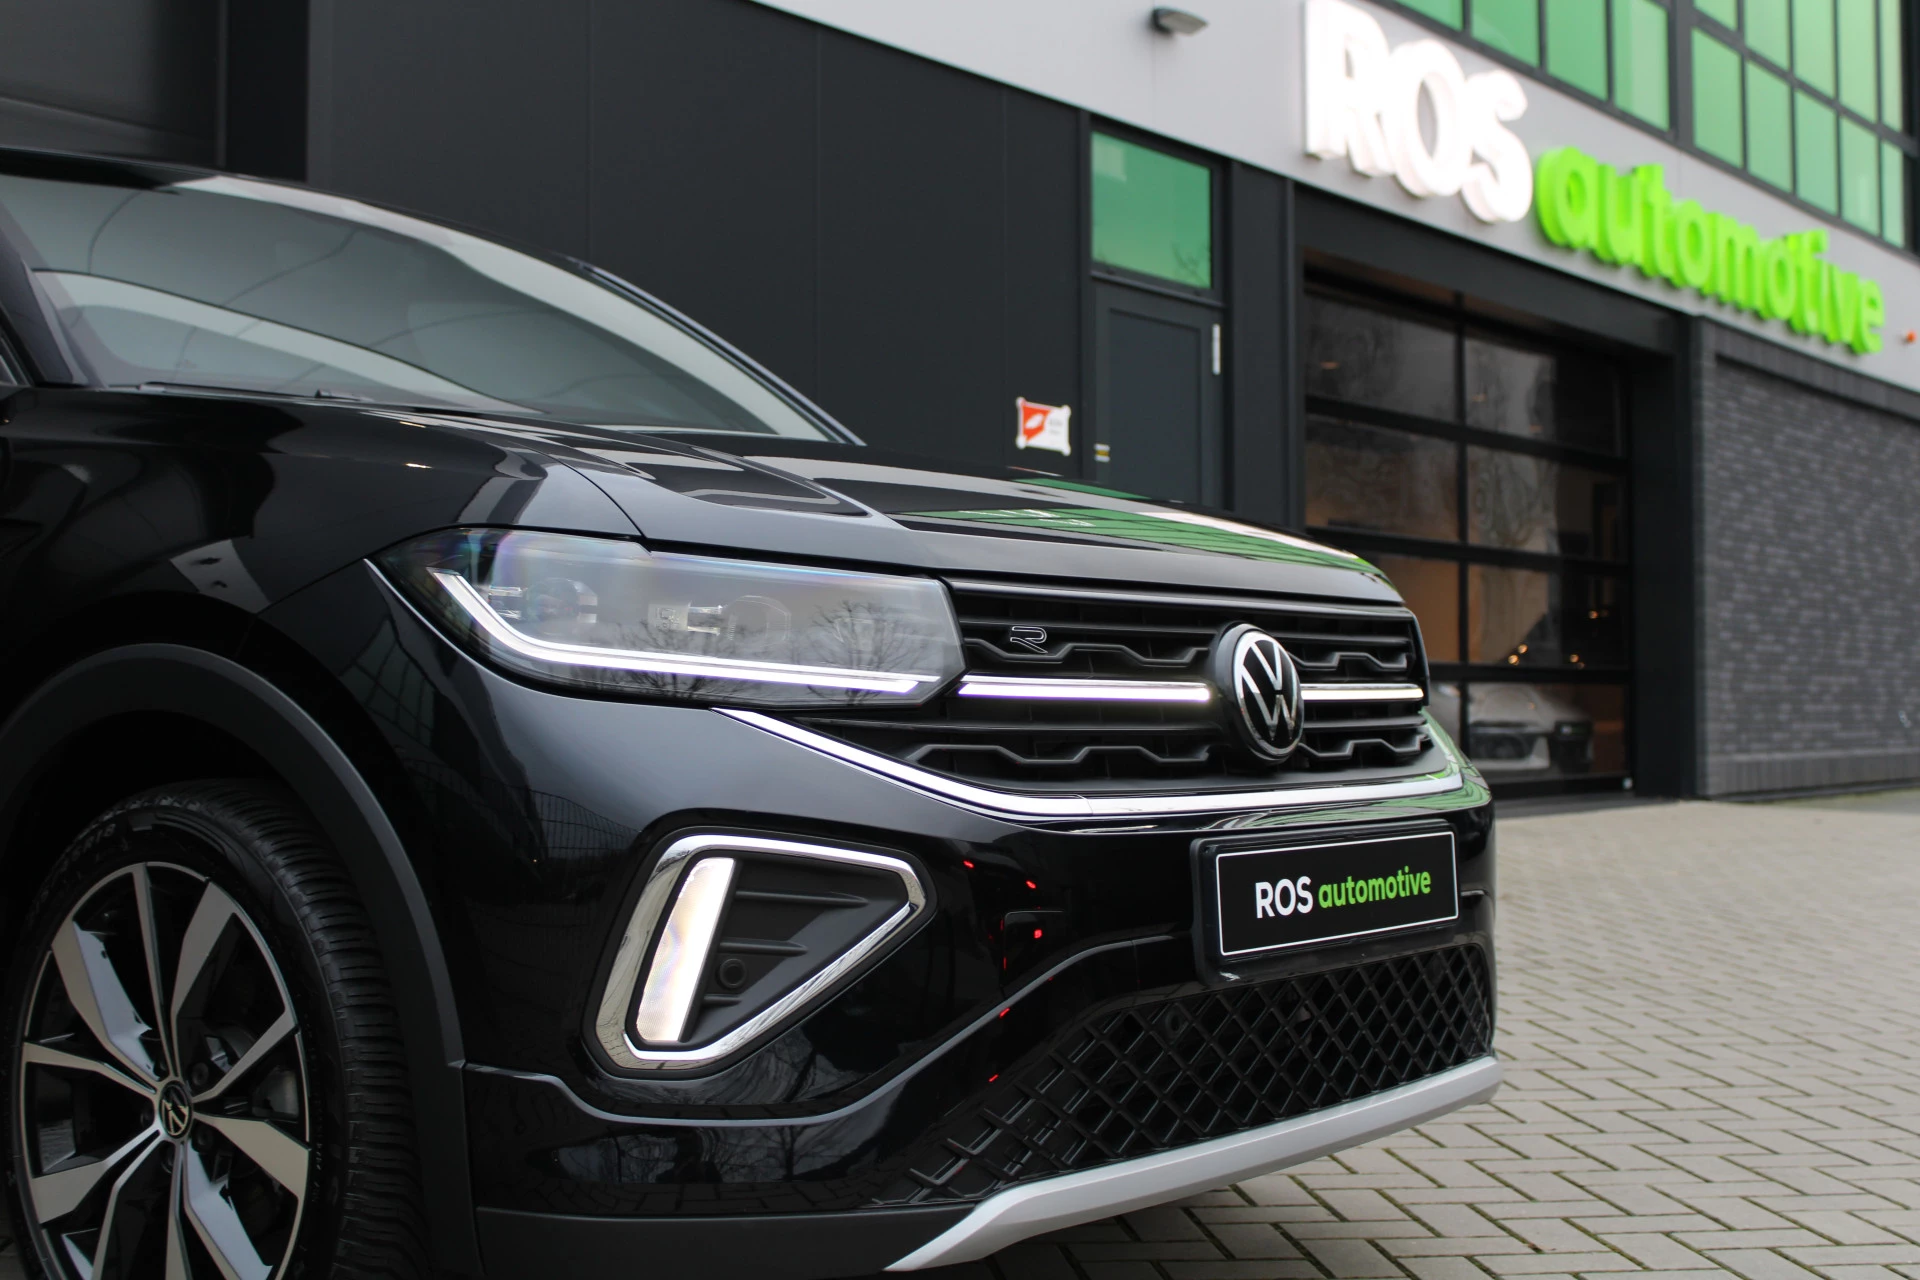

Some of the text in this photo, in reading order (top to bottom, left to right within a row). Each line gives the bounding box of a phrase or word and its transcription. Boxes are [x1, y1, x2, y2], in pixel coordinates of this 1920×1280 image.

[1305, 0, 1884, 354] ROS automotive
[1255, 866, 1431, 919] ROS automotive
